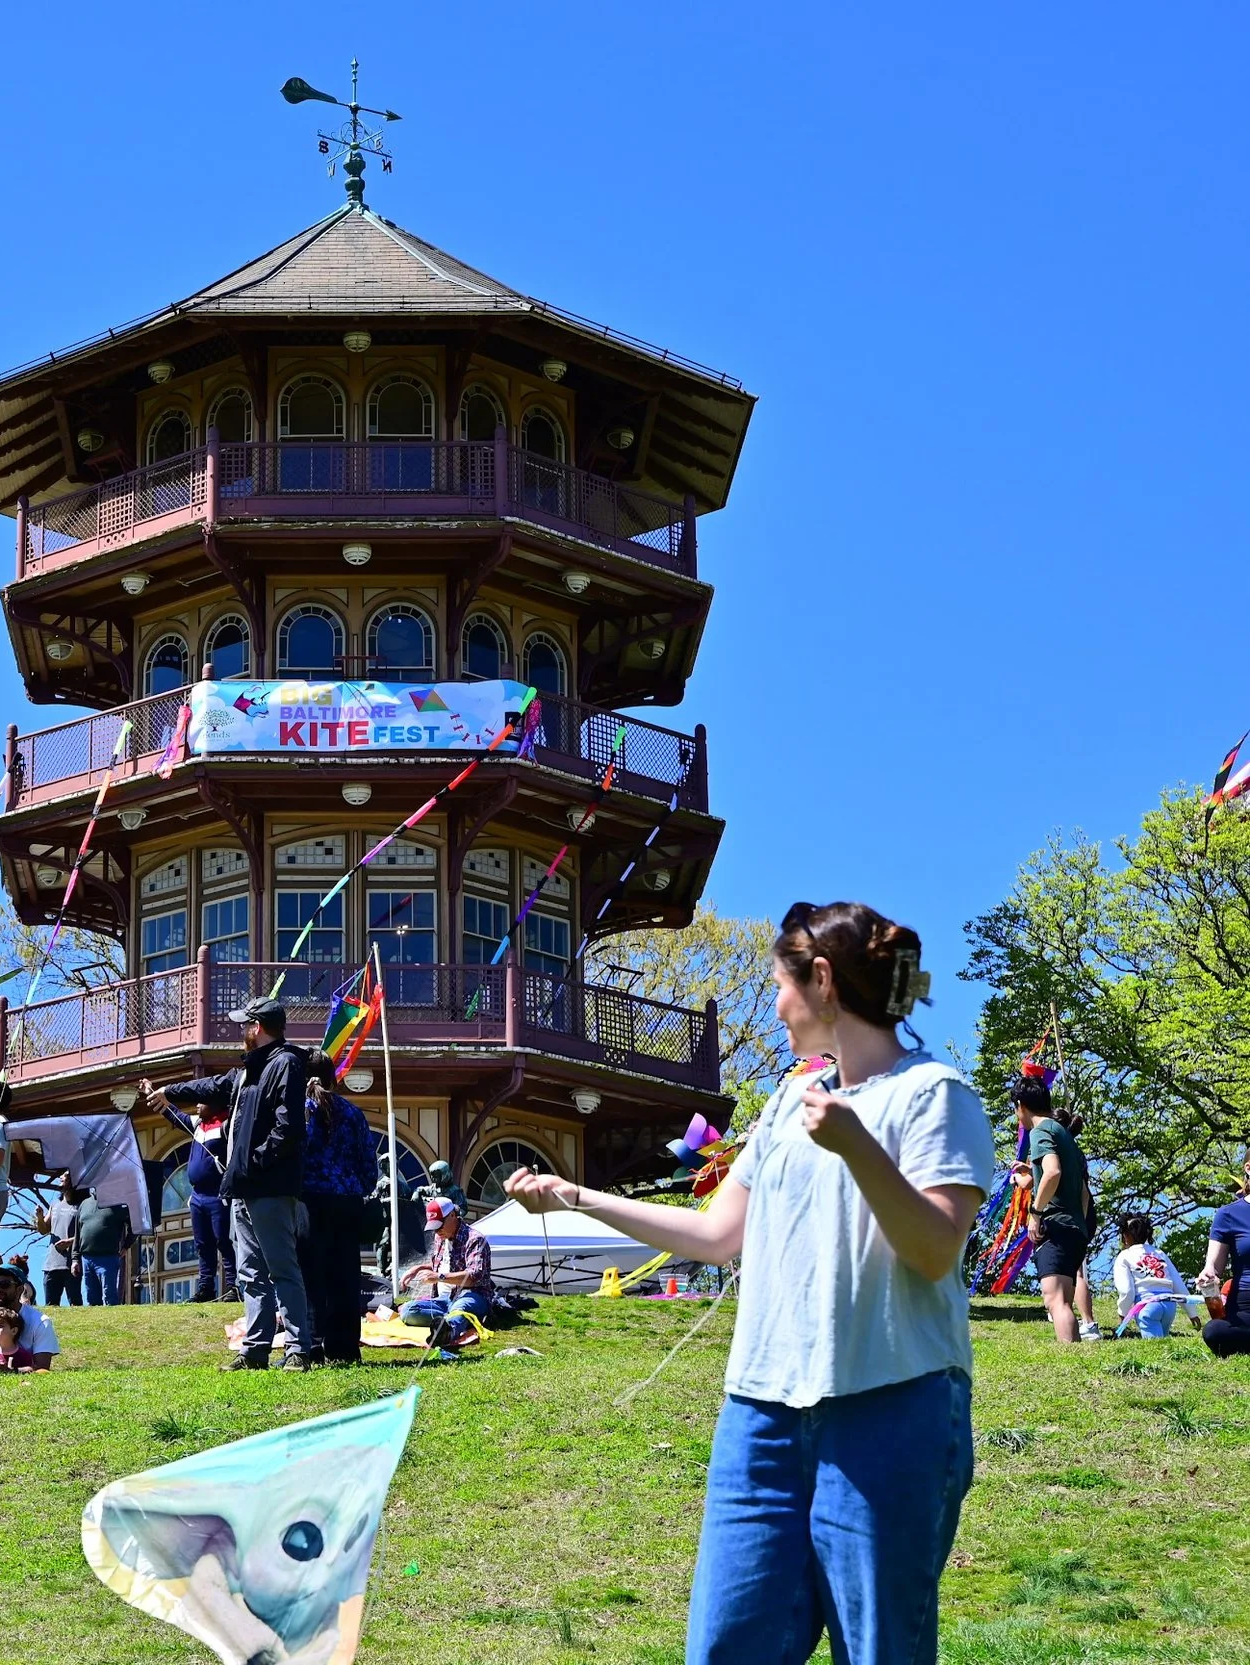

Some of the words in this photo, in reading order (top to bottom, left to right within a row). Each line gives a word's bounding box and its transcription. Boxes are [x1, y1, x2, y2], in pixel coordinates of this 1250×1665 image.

[280, 687, 333, 705] BIG
[279, 705, 397, 720] BALTIMORE
[279, 721, 370, 747] KITE
[374, 725, 441, 743] FEST
